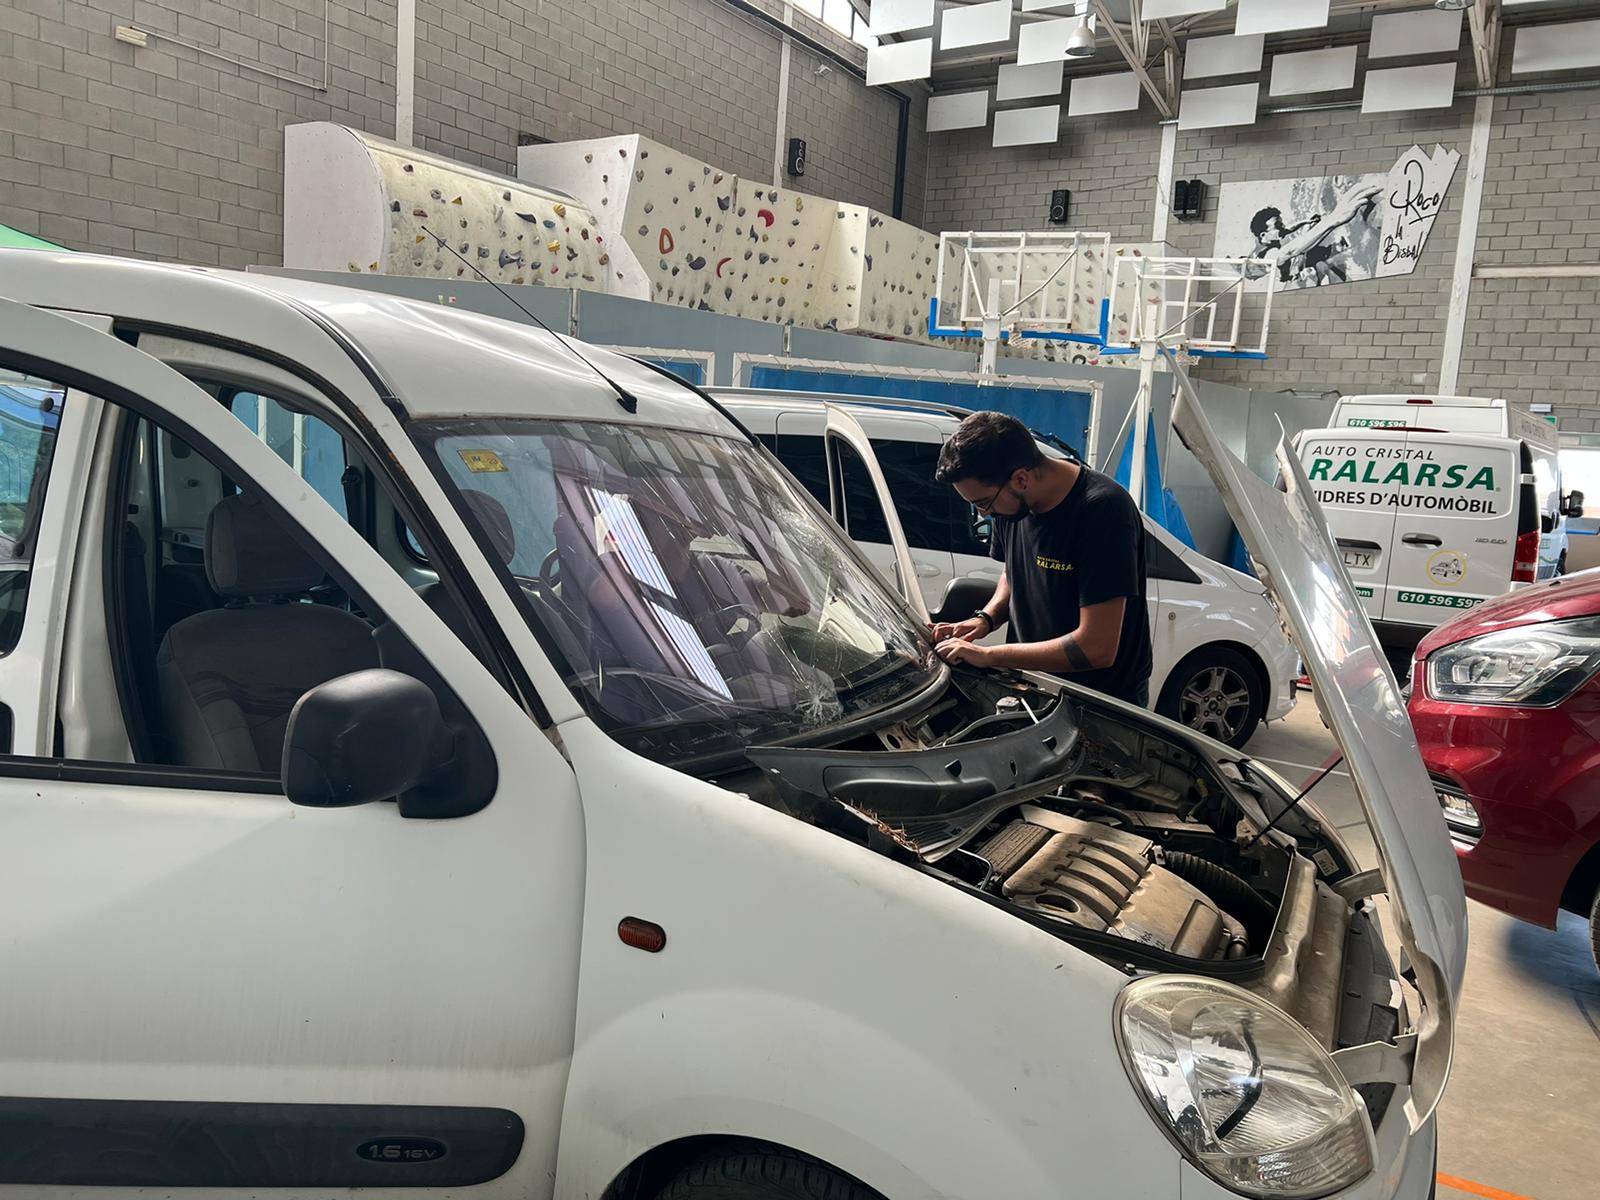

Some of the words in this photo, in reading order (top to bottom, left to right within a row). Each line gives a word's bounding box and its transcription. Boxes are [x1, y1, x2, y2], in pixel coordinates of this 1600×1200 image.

[1349, 419, 1367, 427] 610
[1312, 445, 1357, 456] AUTO
[1365, 447, 1434, 460] CRISTAL
[1308, 458, 1498, 491] RALARSA
[1314, 490, 1365, 504] IDRES
[1400, 592, 1425, 603] 610
[1428, 594, 1453, 606] 596
[368, 1144, 402, 1158] 1.6
[405, 1149, 437, 1158] 16V
